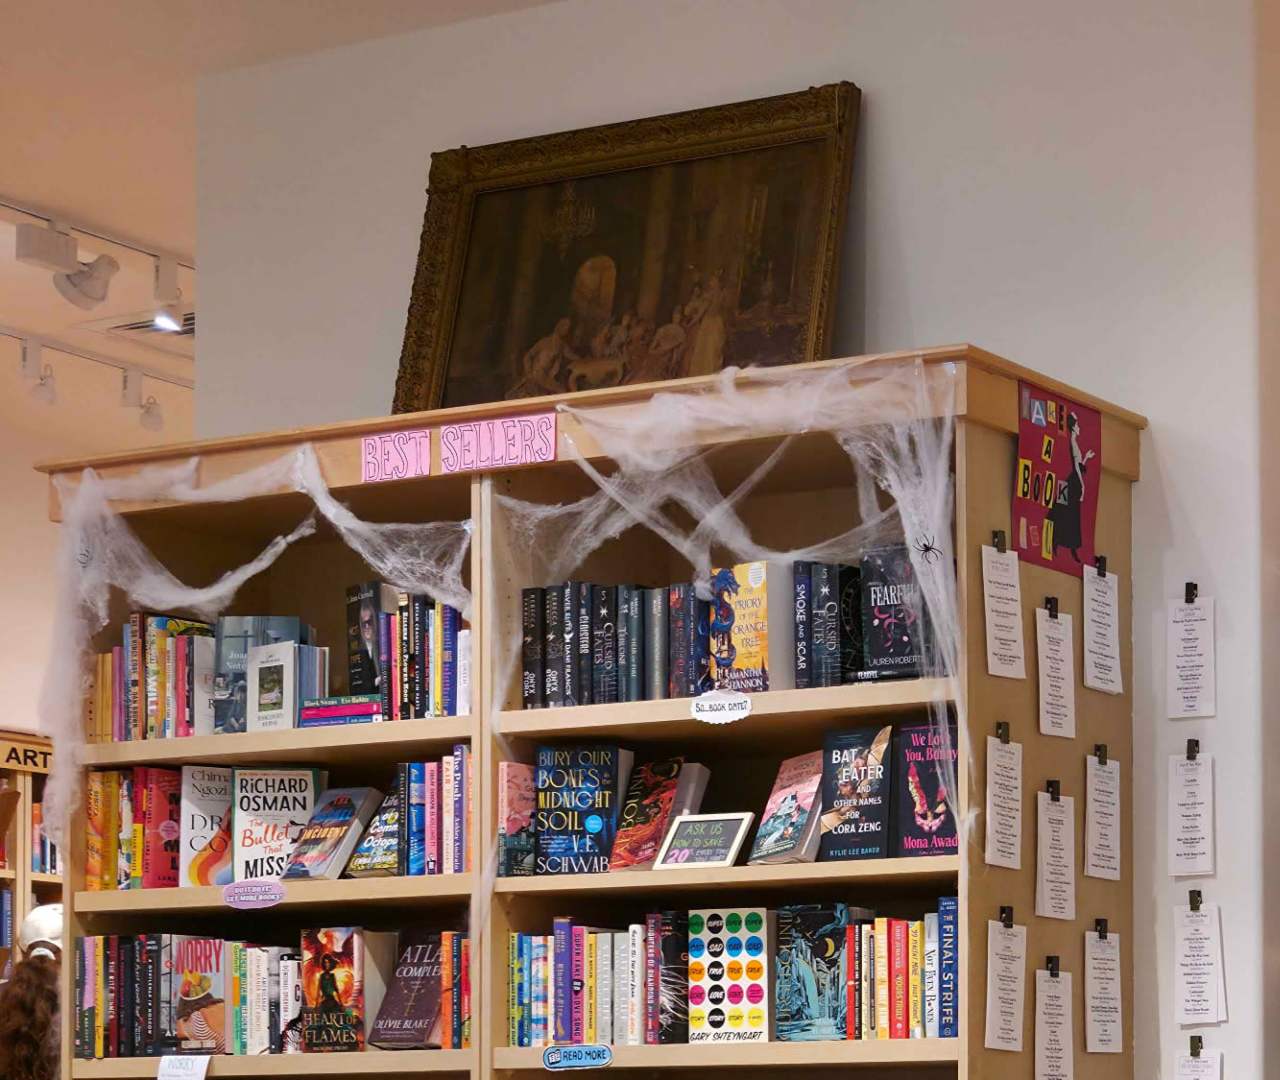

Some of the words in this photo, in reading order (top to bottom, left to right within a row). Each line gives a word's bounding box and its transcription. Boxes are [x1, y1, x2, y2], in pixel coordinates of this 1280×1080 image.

[364, 431, 428, 482] BEST
[442, 414, 554, 474] SELLERS
[1018, 459, 1069, 508] BOOK
[5, 748, 52, 768] ART
[539, 751, 572, 767] BURY
[579, 751, 611, 765] OUR
[832, 749, 857, 764] BAT
[538, 768, 601, 788] BONES
[842, 765, 884, 781] EATER
[856, 785, 871, 793] AND
[240, 796, 307, 812] OSMAN
[536, 791, 610, 809] MIDNIGHT
[833, 799, 858, 808] OTHER
[250, 819, 264, 827] The
[537, 811, 583, 832] SOIL
[847, 811, 859, 819] FOR
[242, 822, 290, 848] Bullet
[832, 824, 855, 834] CORA
[859, 822, 881, 832] ZENG
[571, 835, 599, 853] V.E.
[904, 835, 928, 849] Mona
[931, 833, 959, 848] Awad
[264, 846, 283, 855] That
[536, 856, 609, 874] SCHWAB
[942, 925, 953, 968] FINAL
[176, 939, 223, 975] WORRY
[942, 972, 953, 1024] STRIFE
[303, 1012, 343, 1026] HEART
[374, 1018, 401, 1029] OLIVIE
[403, 1018, 431, 1029] BLAKE
[305, 1028, 357, 1044] FLAMES
[689, 1032, 709, 1041] GARY
[712, 1031, 763, 1041] SHTEYNGART
[563, 1052, 582, 1061] READ
[585, 1050, 606, 1060] MORE
